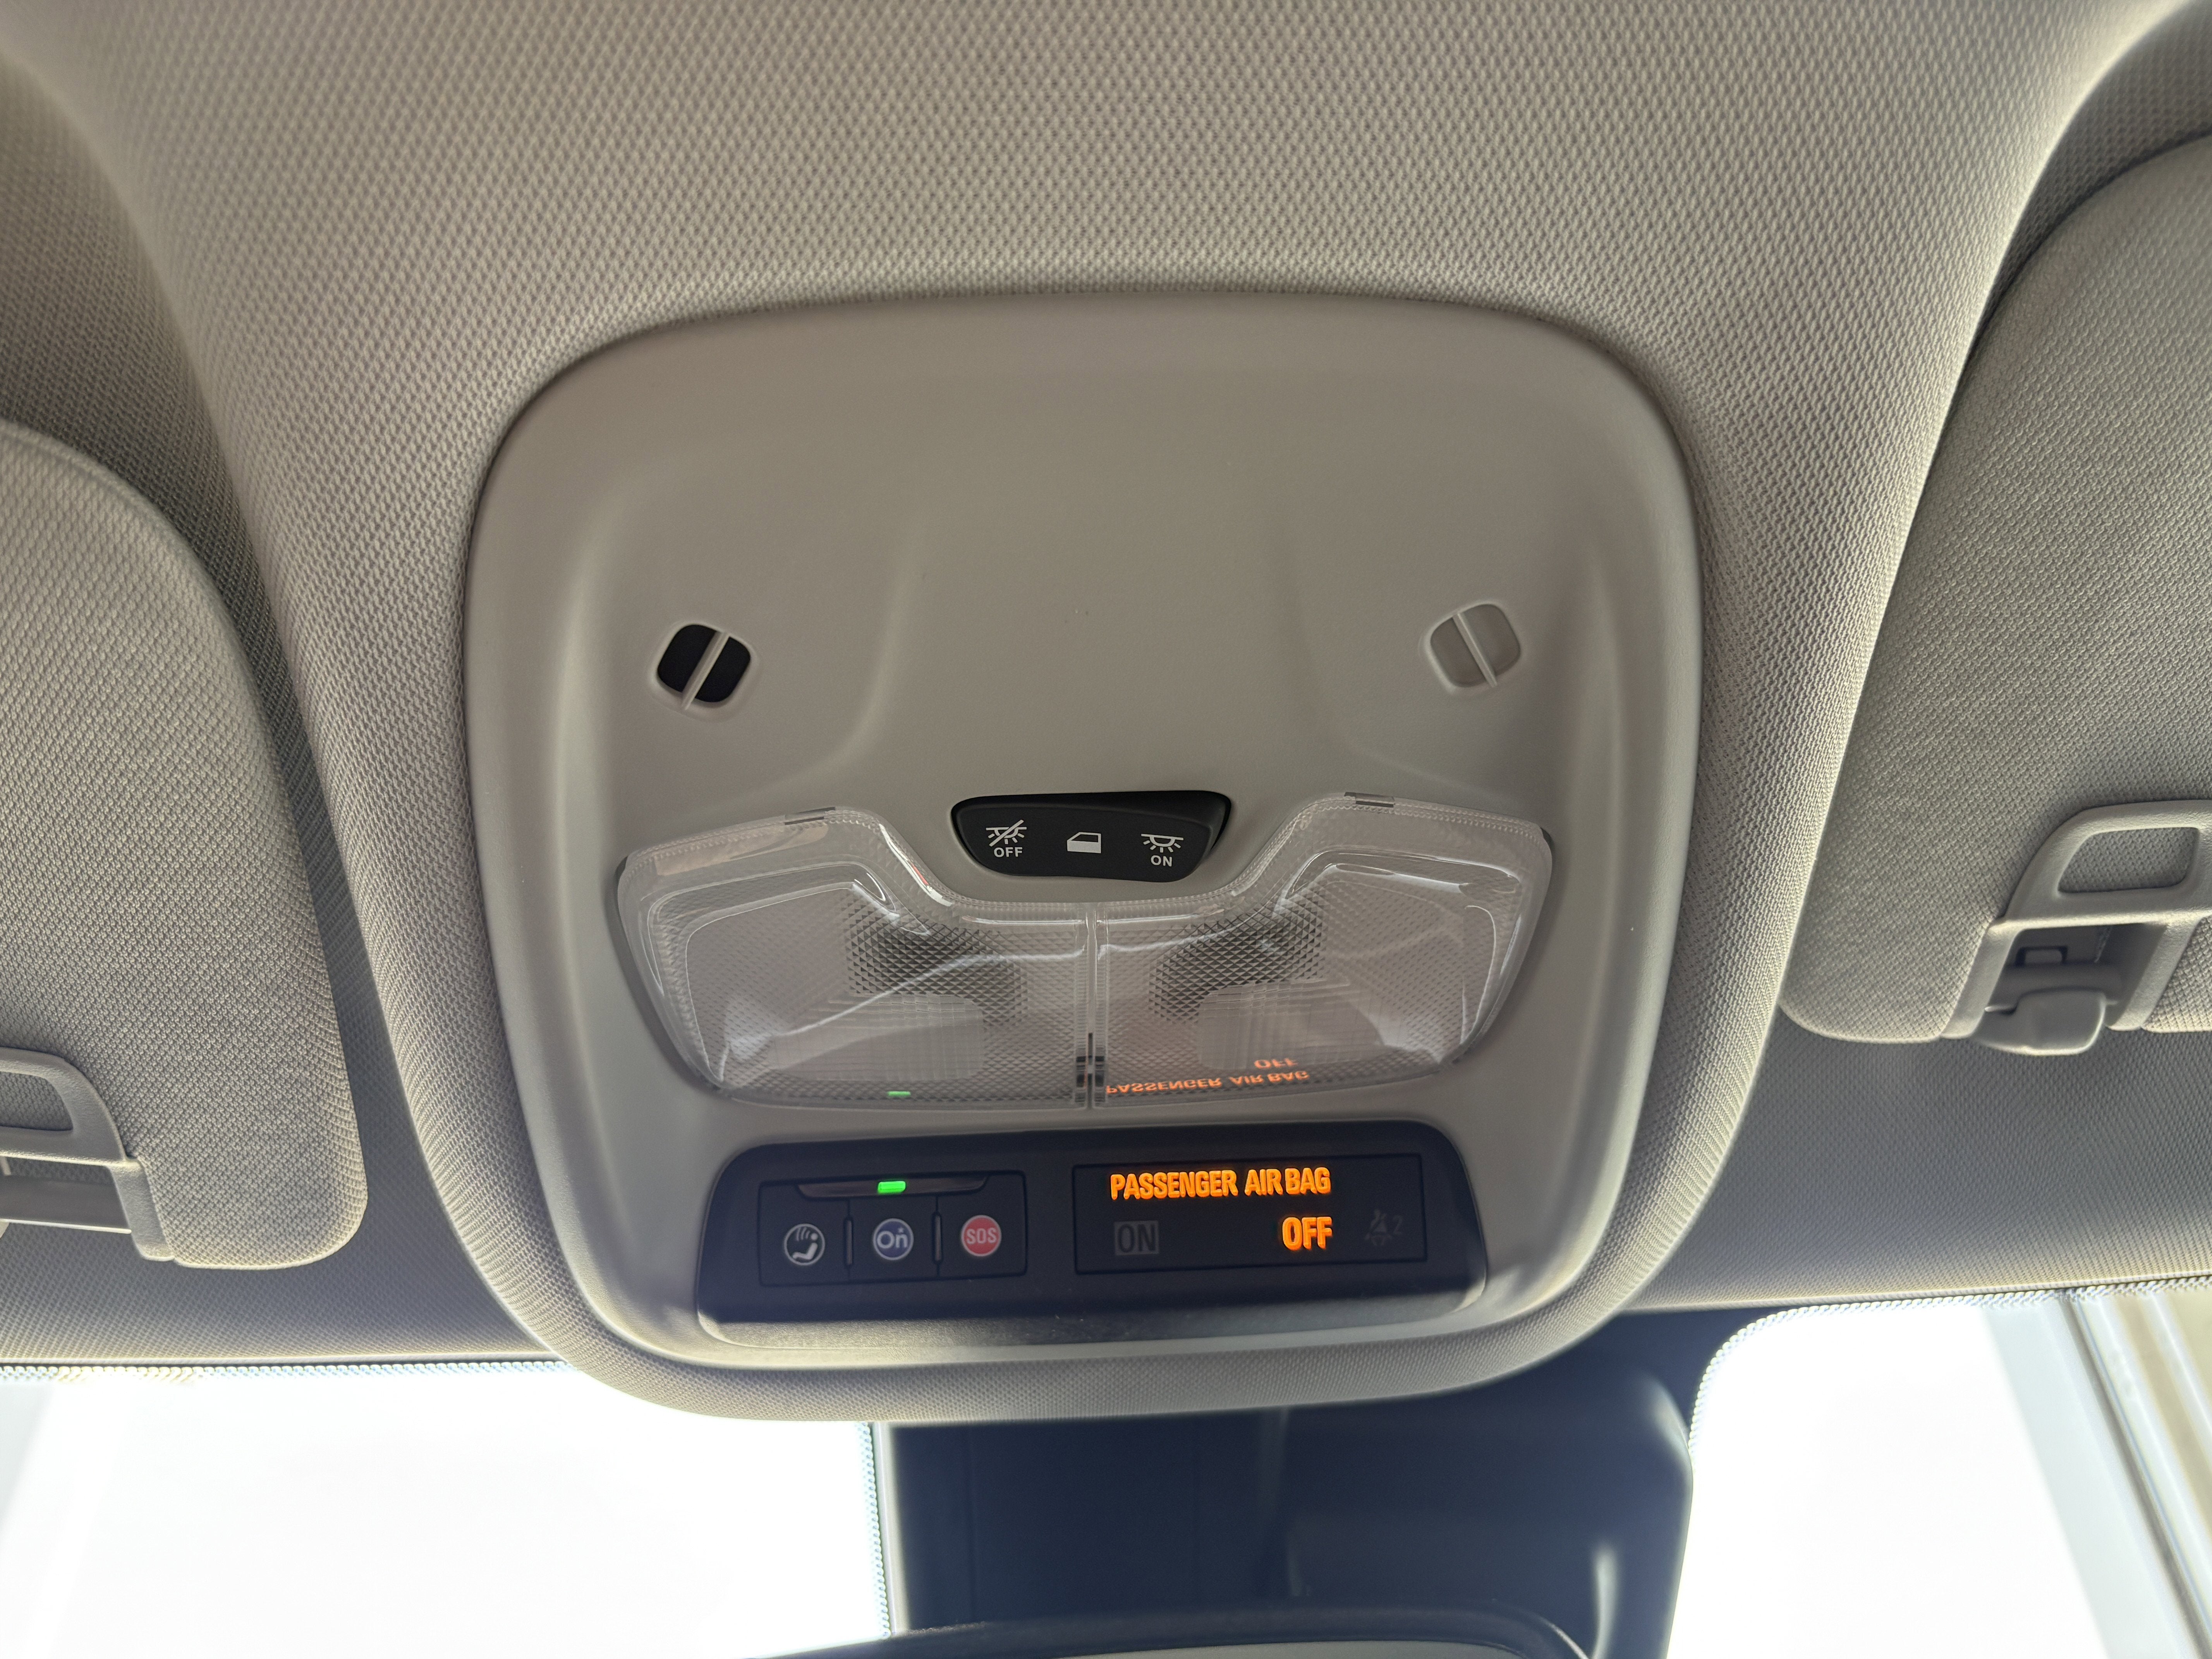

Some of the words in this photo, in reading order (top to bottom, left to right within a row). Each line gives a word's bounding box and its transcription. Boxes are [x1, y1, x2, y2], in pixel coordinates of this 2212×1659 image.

[994, 847, 1023, 857] OFF
[1151, 855, 1172, 867] ON
[1110, 1170, 1238, 1200] PASSENGER
[1245, 1168, 1283, 1196] AIR
[1285, 1166, 1331, 1195] BAG
[966, 1228, 997, 1245] SOS
[1117, 1224, 1156, 1254] ON
[1282, 1216, 1332, 1251] OFF
